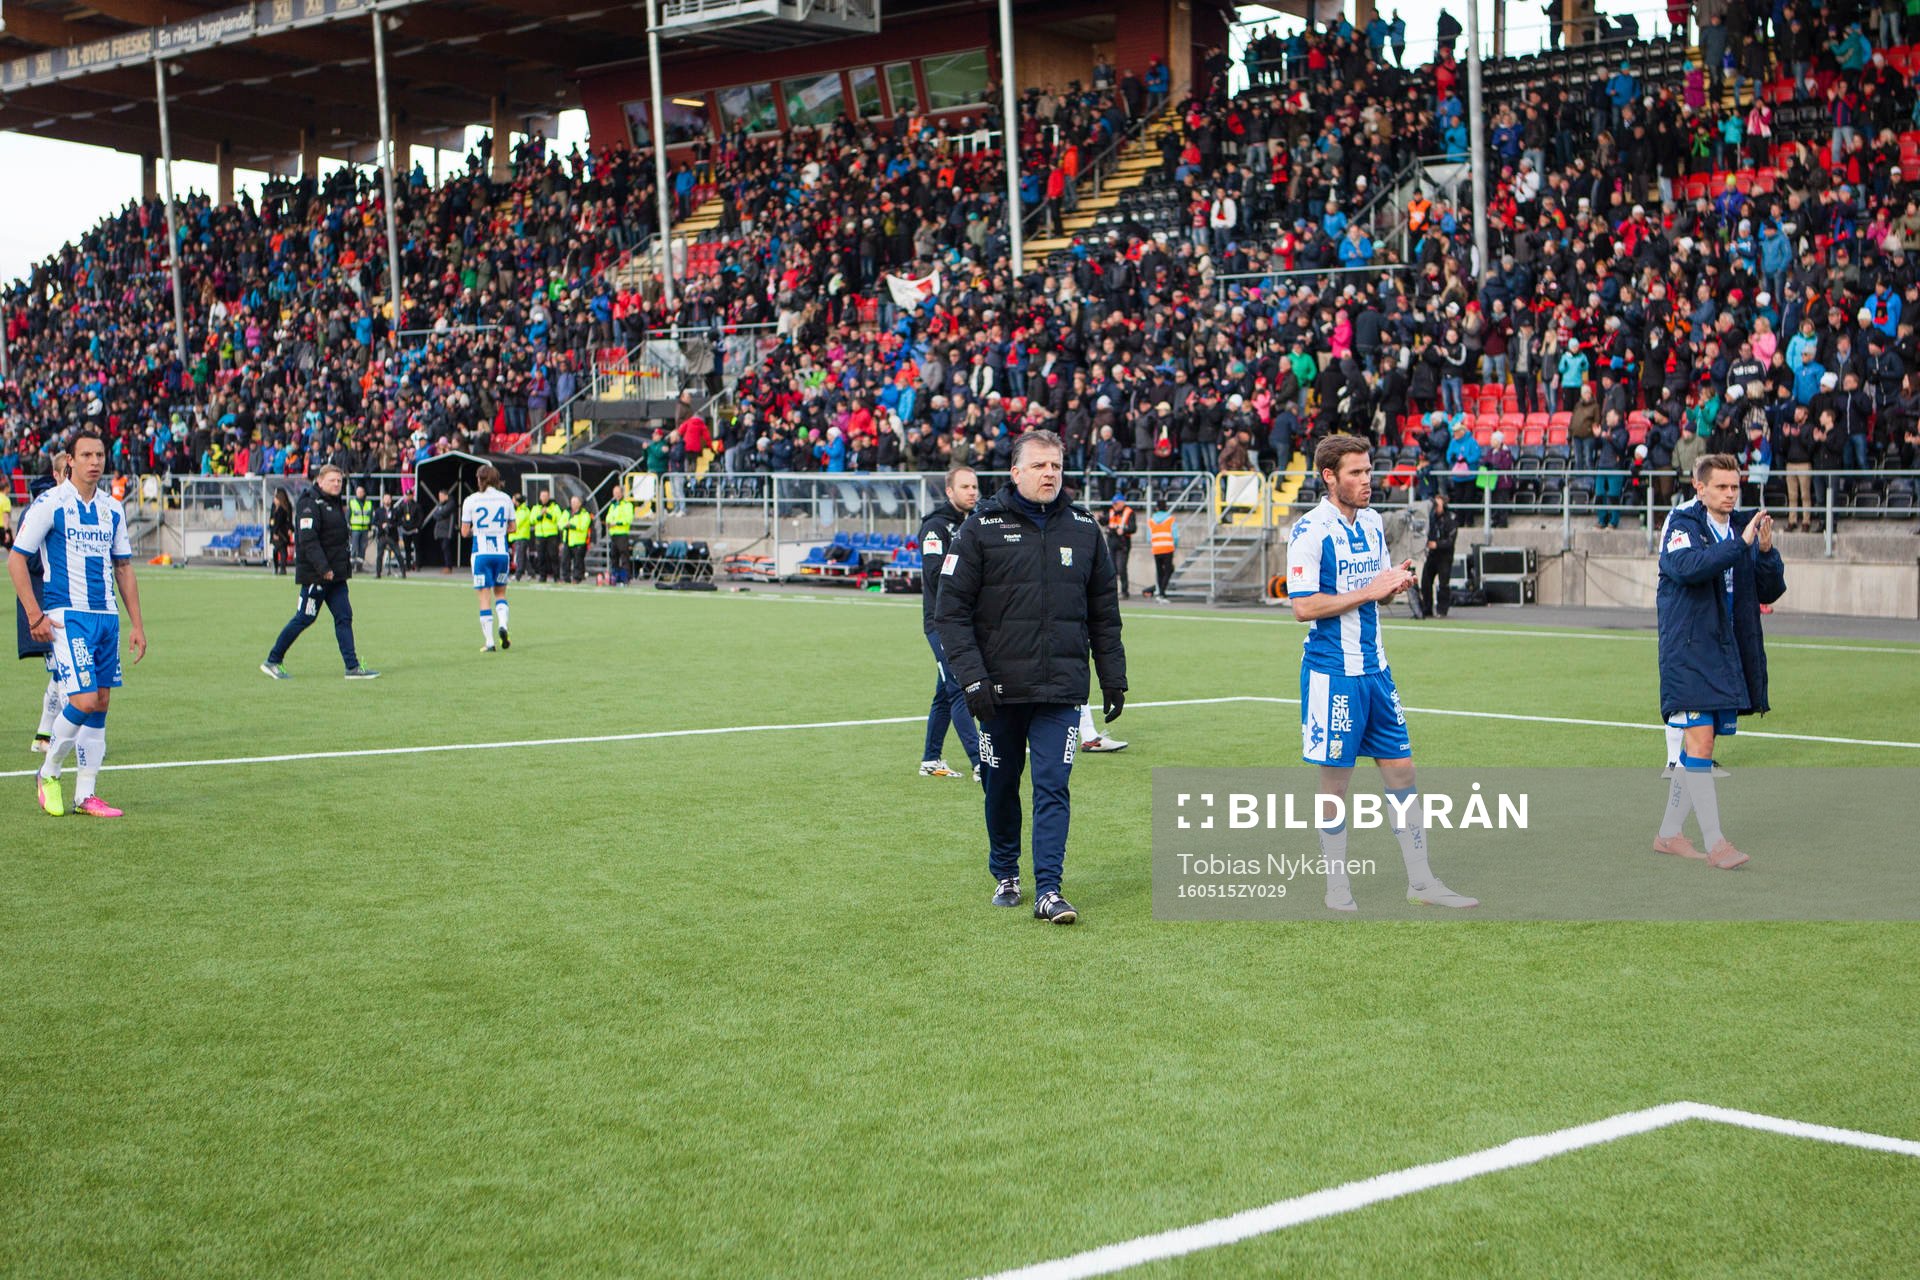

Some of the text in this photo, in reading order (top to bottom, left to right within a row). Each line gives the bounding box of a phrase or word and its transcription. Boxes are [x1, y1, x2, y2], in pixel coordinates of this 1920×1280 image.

[158, 29, 171, 47] En
[173, 24, 197, 44] riktig
[475, 506, 506, 528] 24
[67, 527, 112, 546] Prioritet
[1338, 556, 1380, 575] Prioritet
[1332, 695, 1349, 708] SE
[1332, 707, 1350, 720] RN
[1331, 719, 1353, 732] EKE
[1671, 780, 1682, 807] SKF
